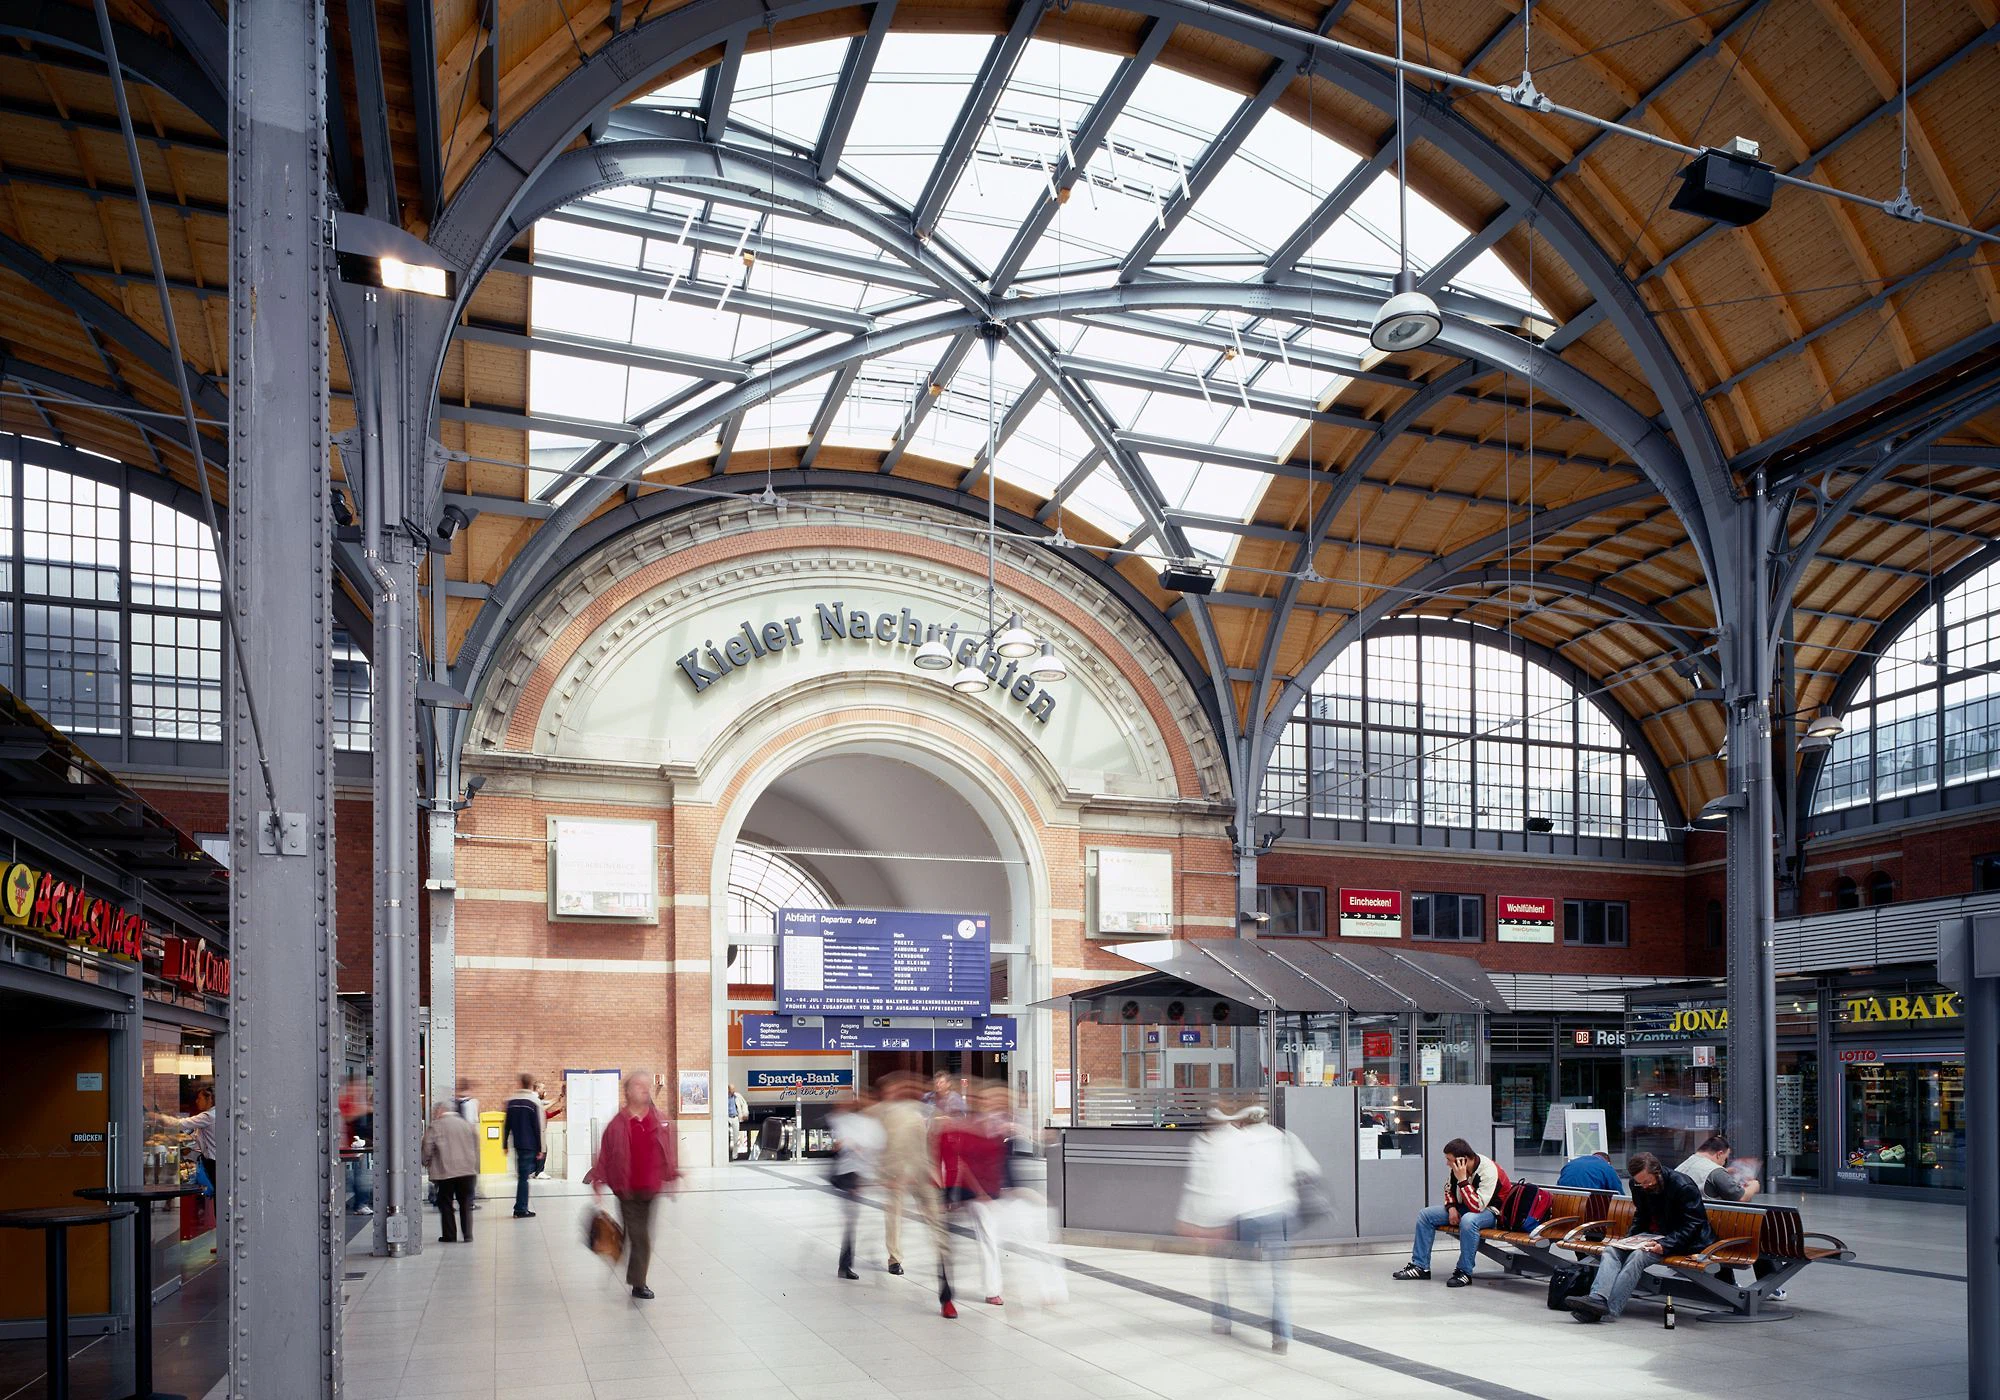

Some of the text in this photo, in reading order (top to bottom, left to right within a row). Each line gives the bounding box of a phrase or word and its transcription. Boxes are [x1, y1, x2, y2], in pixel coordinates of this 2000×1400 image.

[676, 615, 805, 693] Kieler
[1349, 896, 1392, 907] Einchecken!
[1506, 903, 1545, 914] Wohlfühlen!
[32, 871, 143, 962] ASIA-SNACK
[785, 913, 816, 922] Abfahrt
[820, 916, 852, 924] Departure
[1848, 993, 1958, 1022] TABAK
[1577, 1032, 1588, 1043] DB
[1840, 1050, 1877, 1061] LOTTO
[758, 1072, 839, 1086] Sparda-Bank
[74, 1133, 103, 1142] DRÜCKEN
